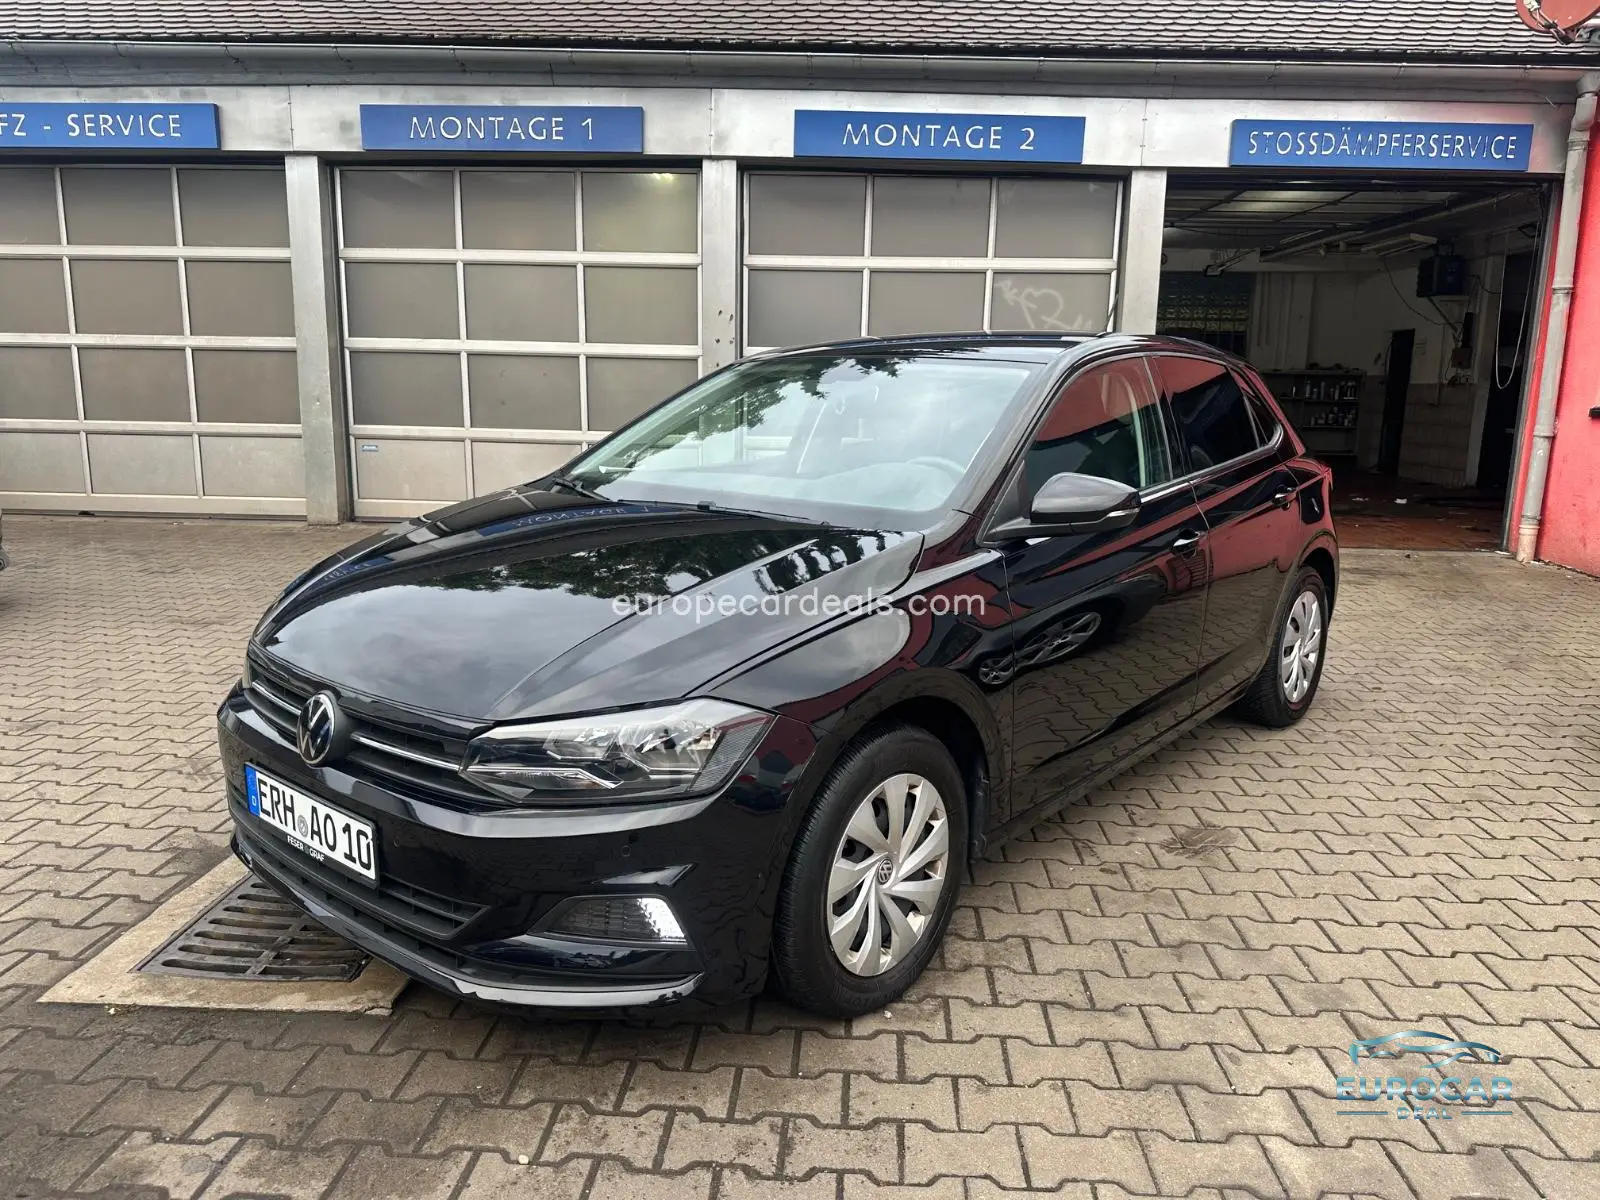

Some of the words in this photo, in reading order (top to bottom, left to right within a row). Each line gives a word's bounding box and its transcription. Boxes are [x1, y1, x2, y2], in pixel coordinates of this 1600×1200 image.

[67, 113, 182, 137] SERVICE
[409, 116, 564, 141] MONTAGE
[581, 118, 593, 141] 1
[842, 123, 1002, 149] MONTAGE
[1019, 127, 1035, 150] 2
[1248, 126, 1517, 160] STOSSDÄMPFERSERVICE
[257, 777, 297, 832] ERH
[310, 805, 337, 852] AO
[342, 822, 372, 872] 10
